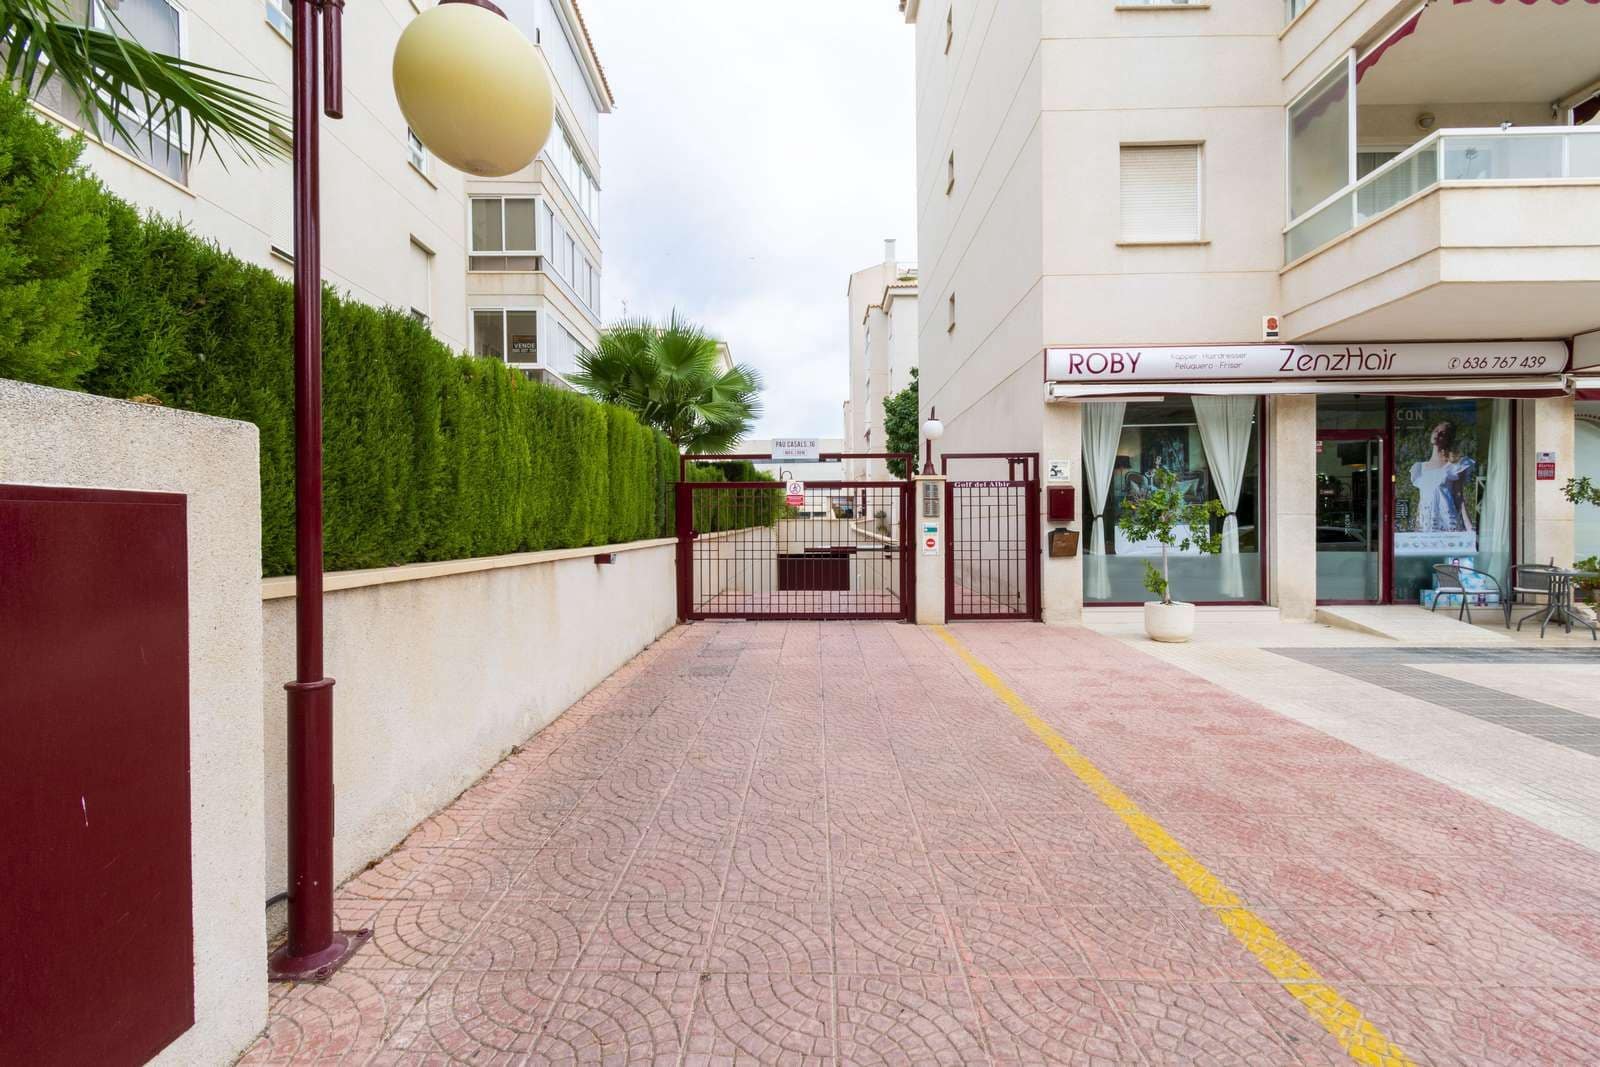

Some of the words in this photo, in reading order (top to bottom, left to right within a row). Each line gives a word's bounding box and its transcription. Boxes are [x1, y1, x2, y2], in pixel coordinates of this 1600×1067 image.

[1068, 352, 1141, 374] ROBY
[1279, 346, 1397, 372] ZenzHair
[1462, 357, 1487, 369] 636
[1490, 357, 1517, 369] 767
[1520, 356, 1546, 368] 439
[775, 440, 786, 448] PAU
